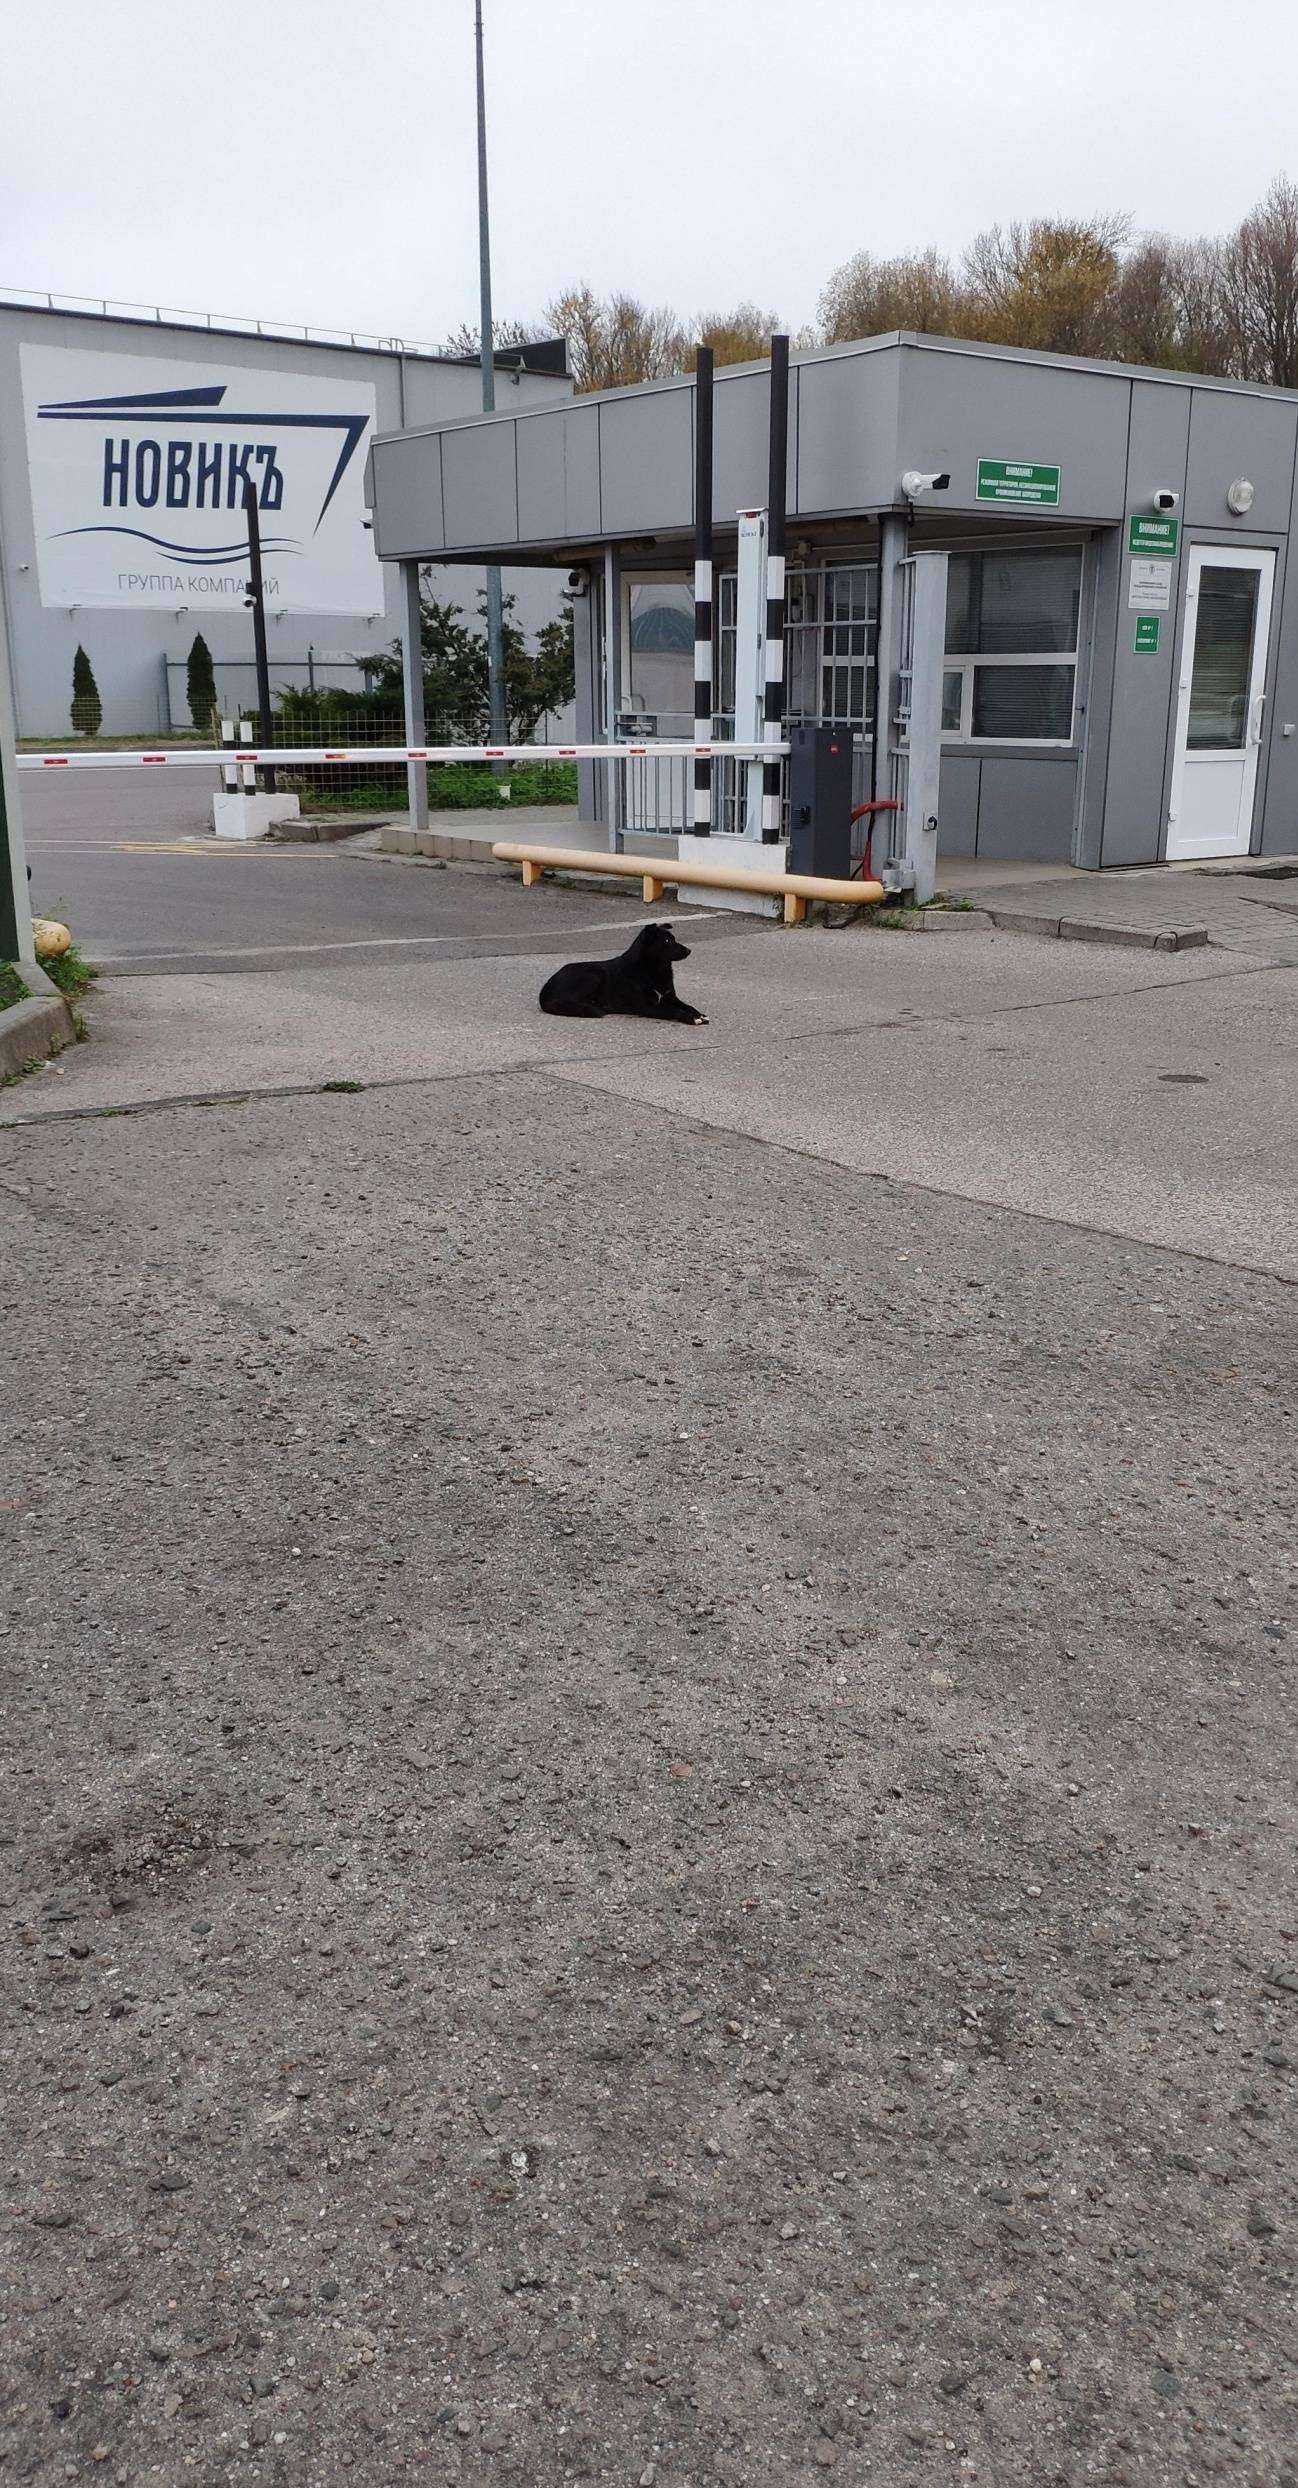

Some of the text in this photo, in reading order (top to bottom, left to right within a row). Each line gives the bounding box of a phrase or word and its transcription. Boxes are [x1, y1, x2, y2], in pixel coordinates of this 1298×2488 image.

[102, 438, 284, 511] НОВИКЪ
[117, 573, 281, 595] ГРУППА КОМПАИЙ
